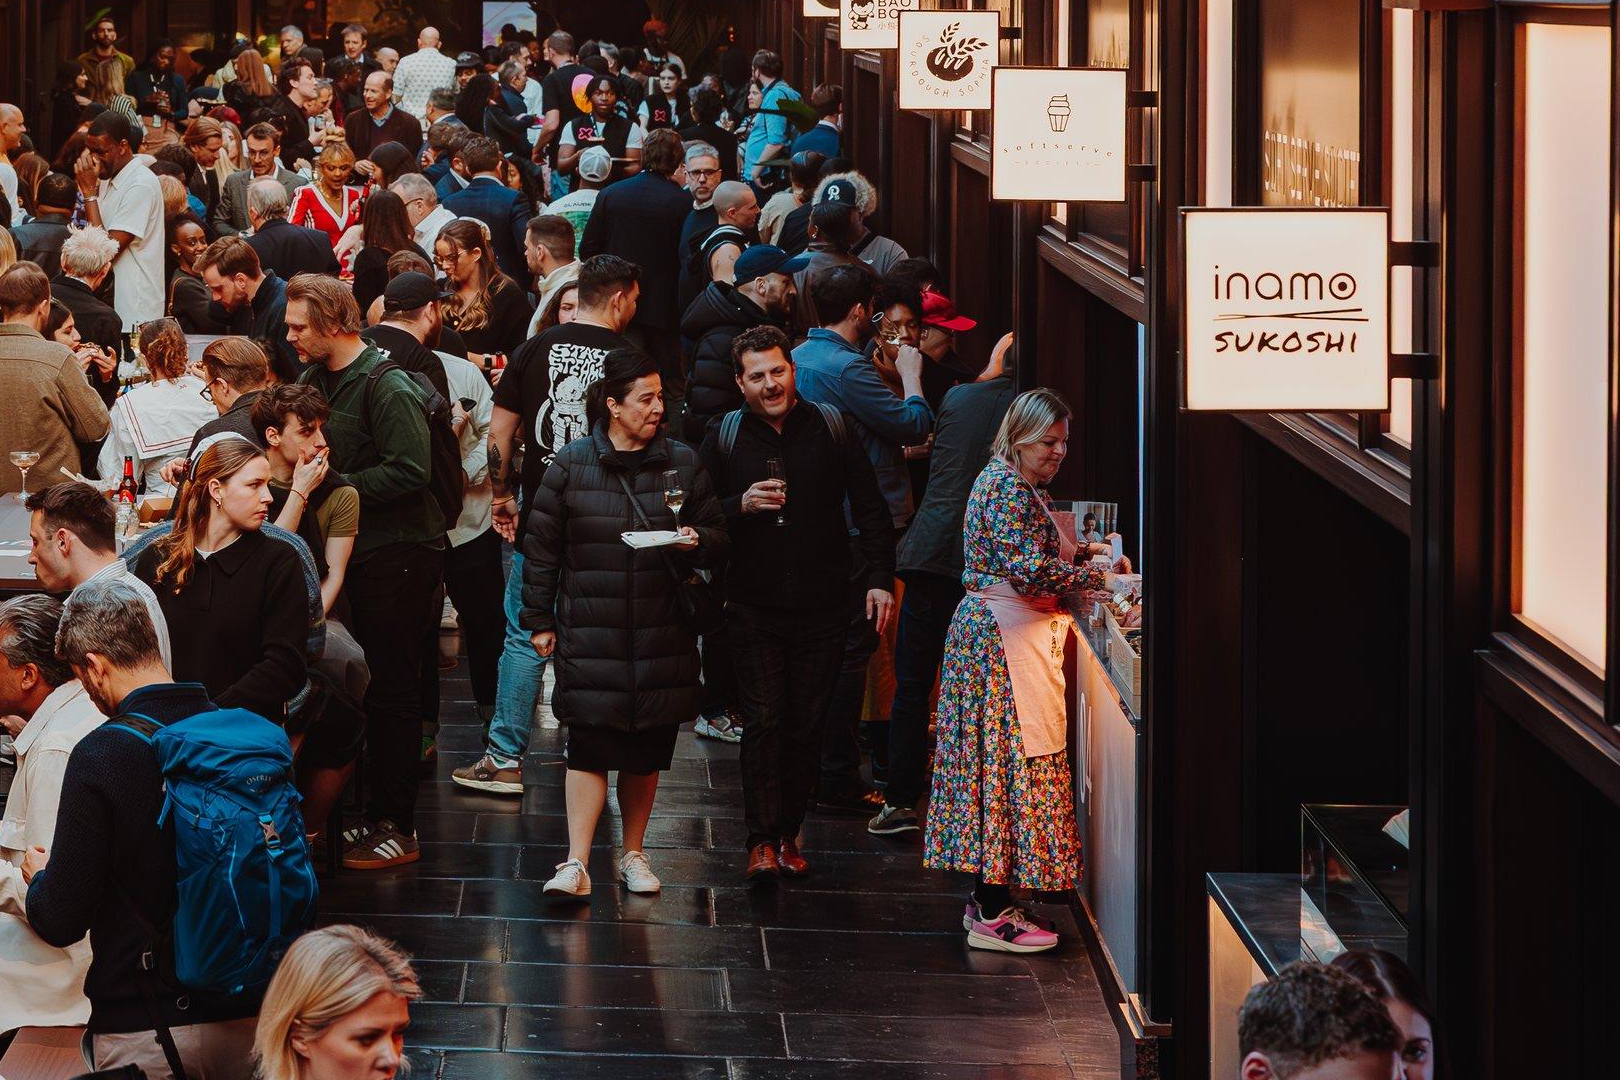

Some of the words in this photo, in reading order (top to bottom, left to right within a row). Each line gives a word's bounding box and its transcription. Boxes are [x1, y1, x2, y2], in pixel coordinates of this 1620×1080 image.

[878, 8, 904, 19] BO
[909, 34, 950, 98] SOURDOUGH
[958, 58, 990, 97] SOPHIA
[1003, 142, 1113, 157] softserve
[1214, 264, 1357, 301] inamo
[1213, 331, 1357, 353] SUKOSHI
